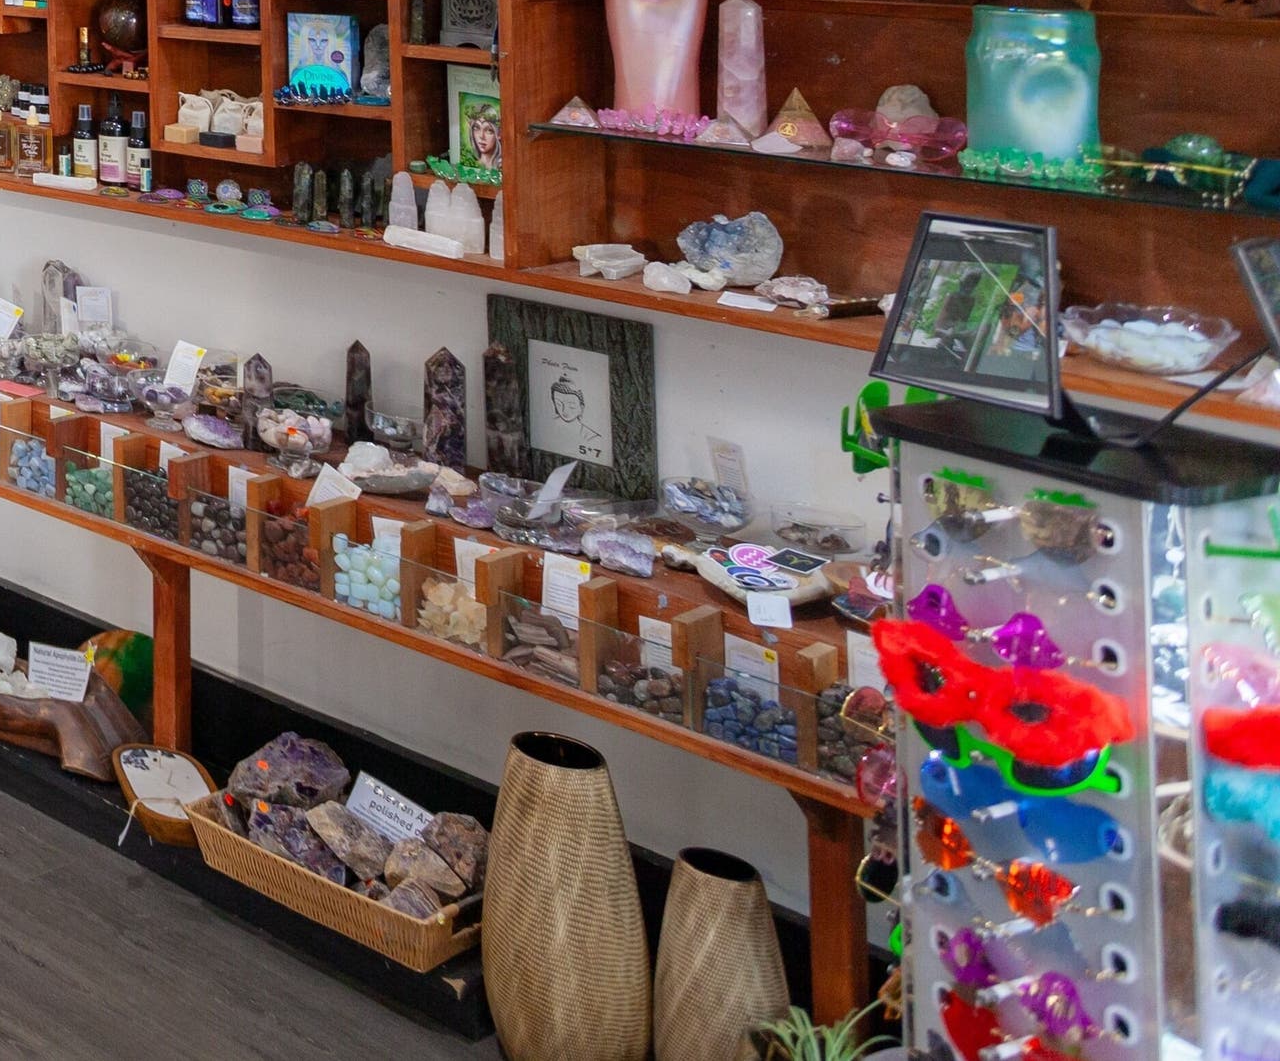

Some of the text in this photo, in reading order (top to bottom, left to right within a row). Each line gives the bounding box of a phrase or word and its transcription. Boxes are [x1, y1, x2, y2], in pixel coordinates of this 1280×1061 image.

[304, 70, 334, 82] DIVINE
[34, 647, 52, 656] Natural
[374, 785, 414, 816] Chevron
[370, 800, 413, 831] polished
